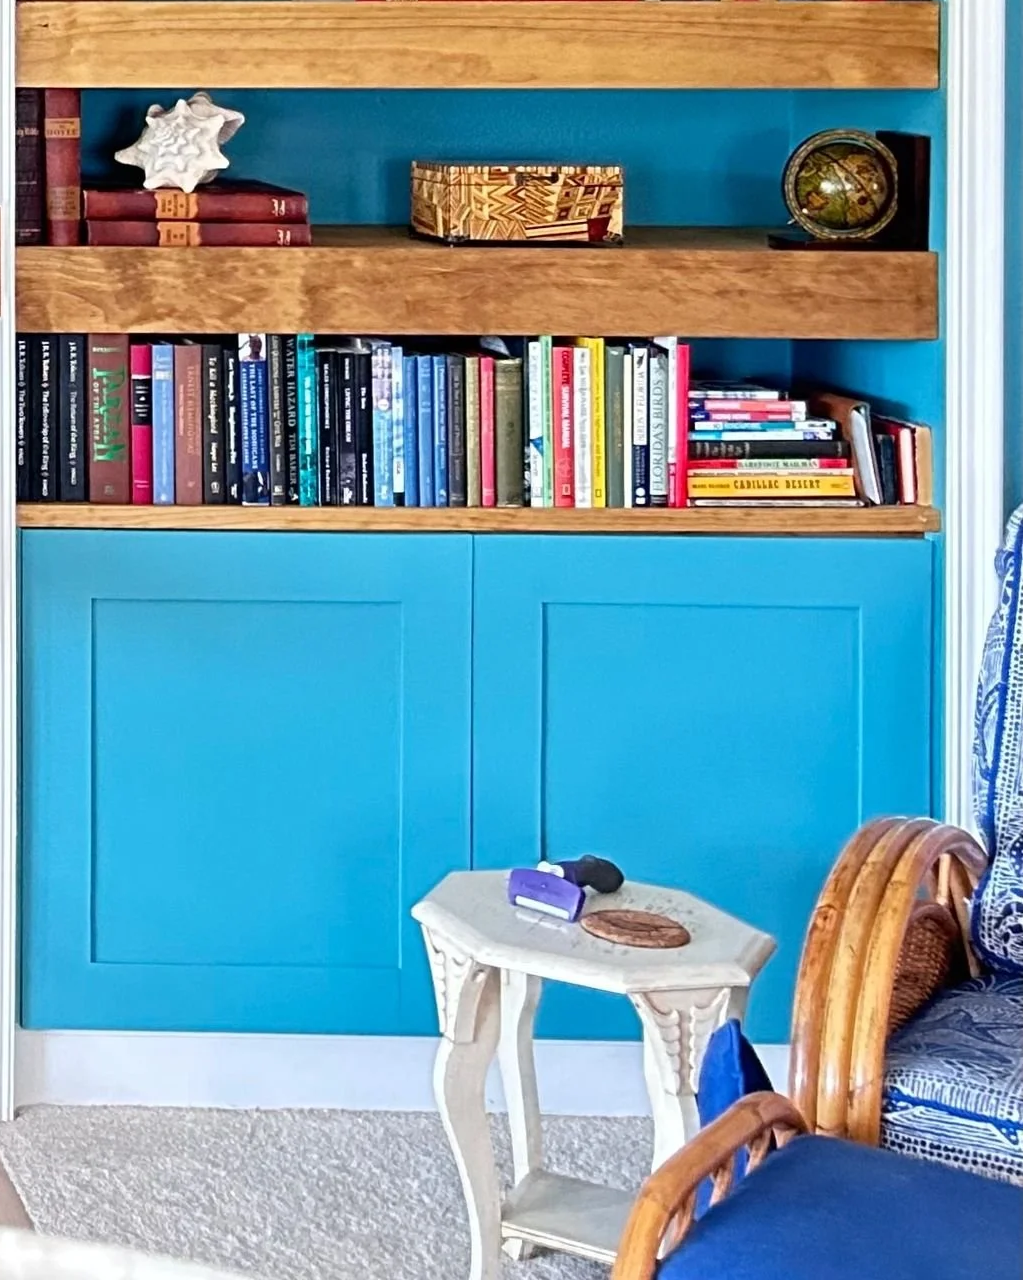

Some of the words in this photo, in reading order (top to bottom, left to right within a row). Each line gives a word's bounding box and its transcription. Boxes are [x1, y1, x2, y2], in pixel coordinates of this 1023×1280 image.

[209, 357, 217, 366] To
[286, 339, 295, 378] WATER
[209, 368, 217, 380] Kill
[42, 391, 50, 402] The
[93, 382, 100, 394] OF
[250, 402, 257, 412] OF
[287, 382, 296, 428] HAZARD
[562, 386, 571, 418] SURVIVAL
[652, 380, 663, 419] BIRDS
[208, 390, 218, 434] Mockingbird
[70, 424, 78, 432] of
[563, 419, 571, 449] MANUAL
[289, 433, 297, 451] TIM
[69, 444, 78, 459] King
[652, 423, 664, 492] FLORIDA'S
[289, 454, 297, 485] BAKER
[734, 479, 780, 489] CADILLAC
[786, 479, 821, 489] DESERT
